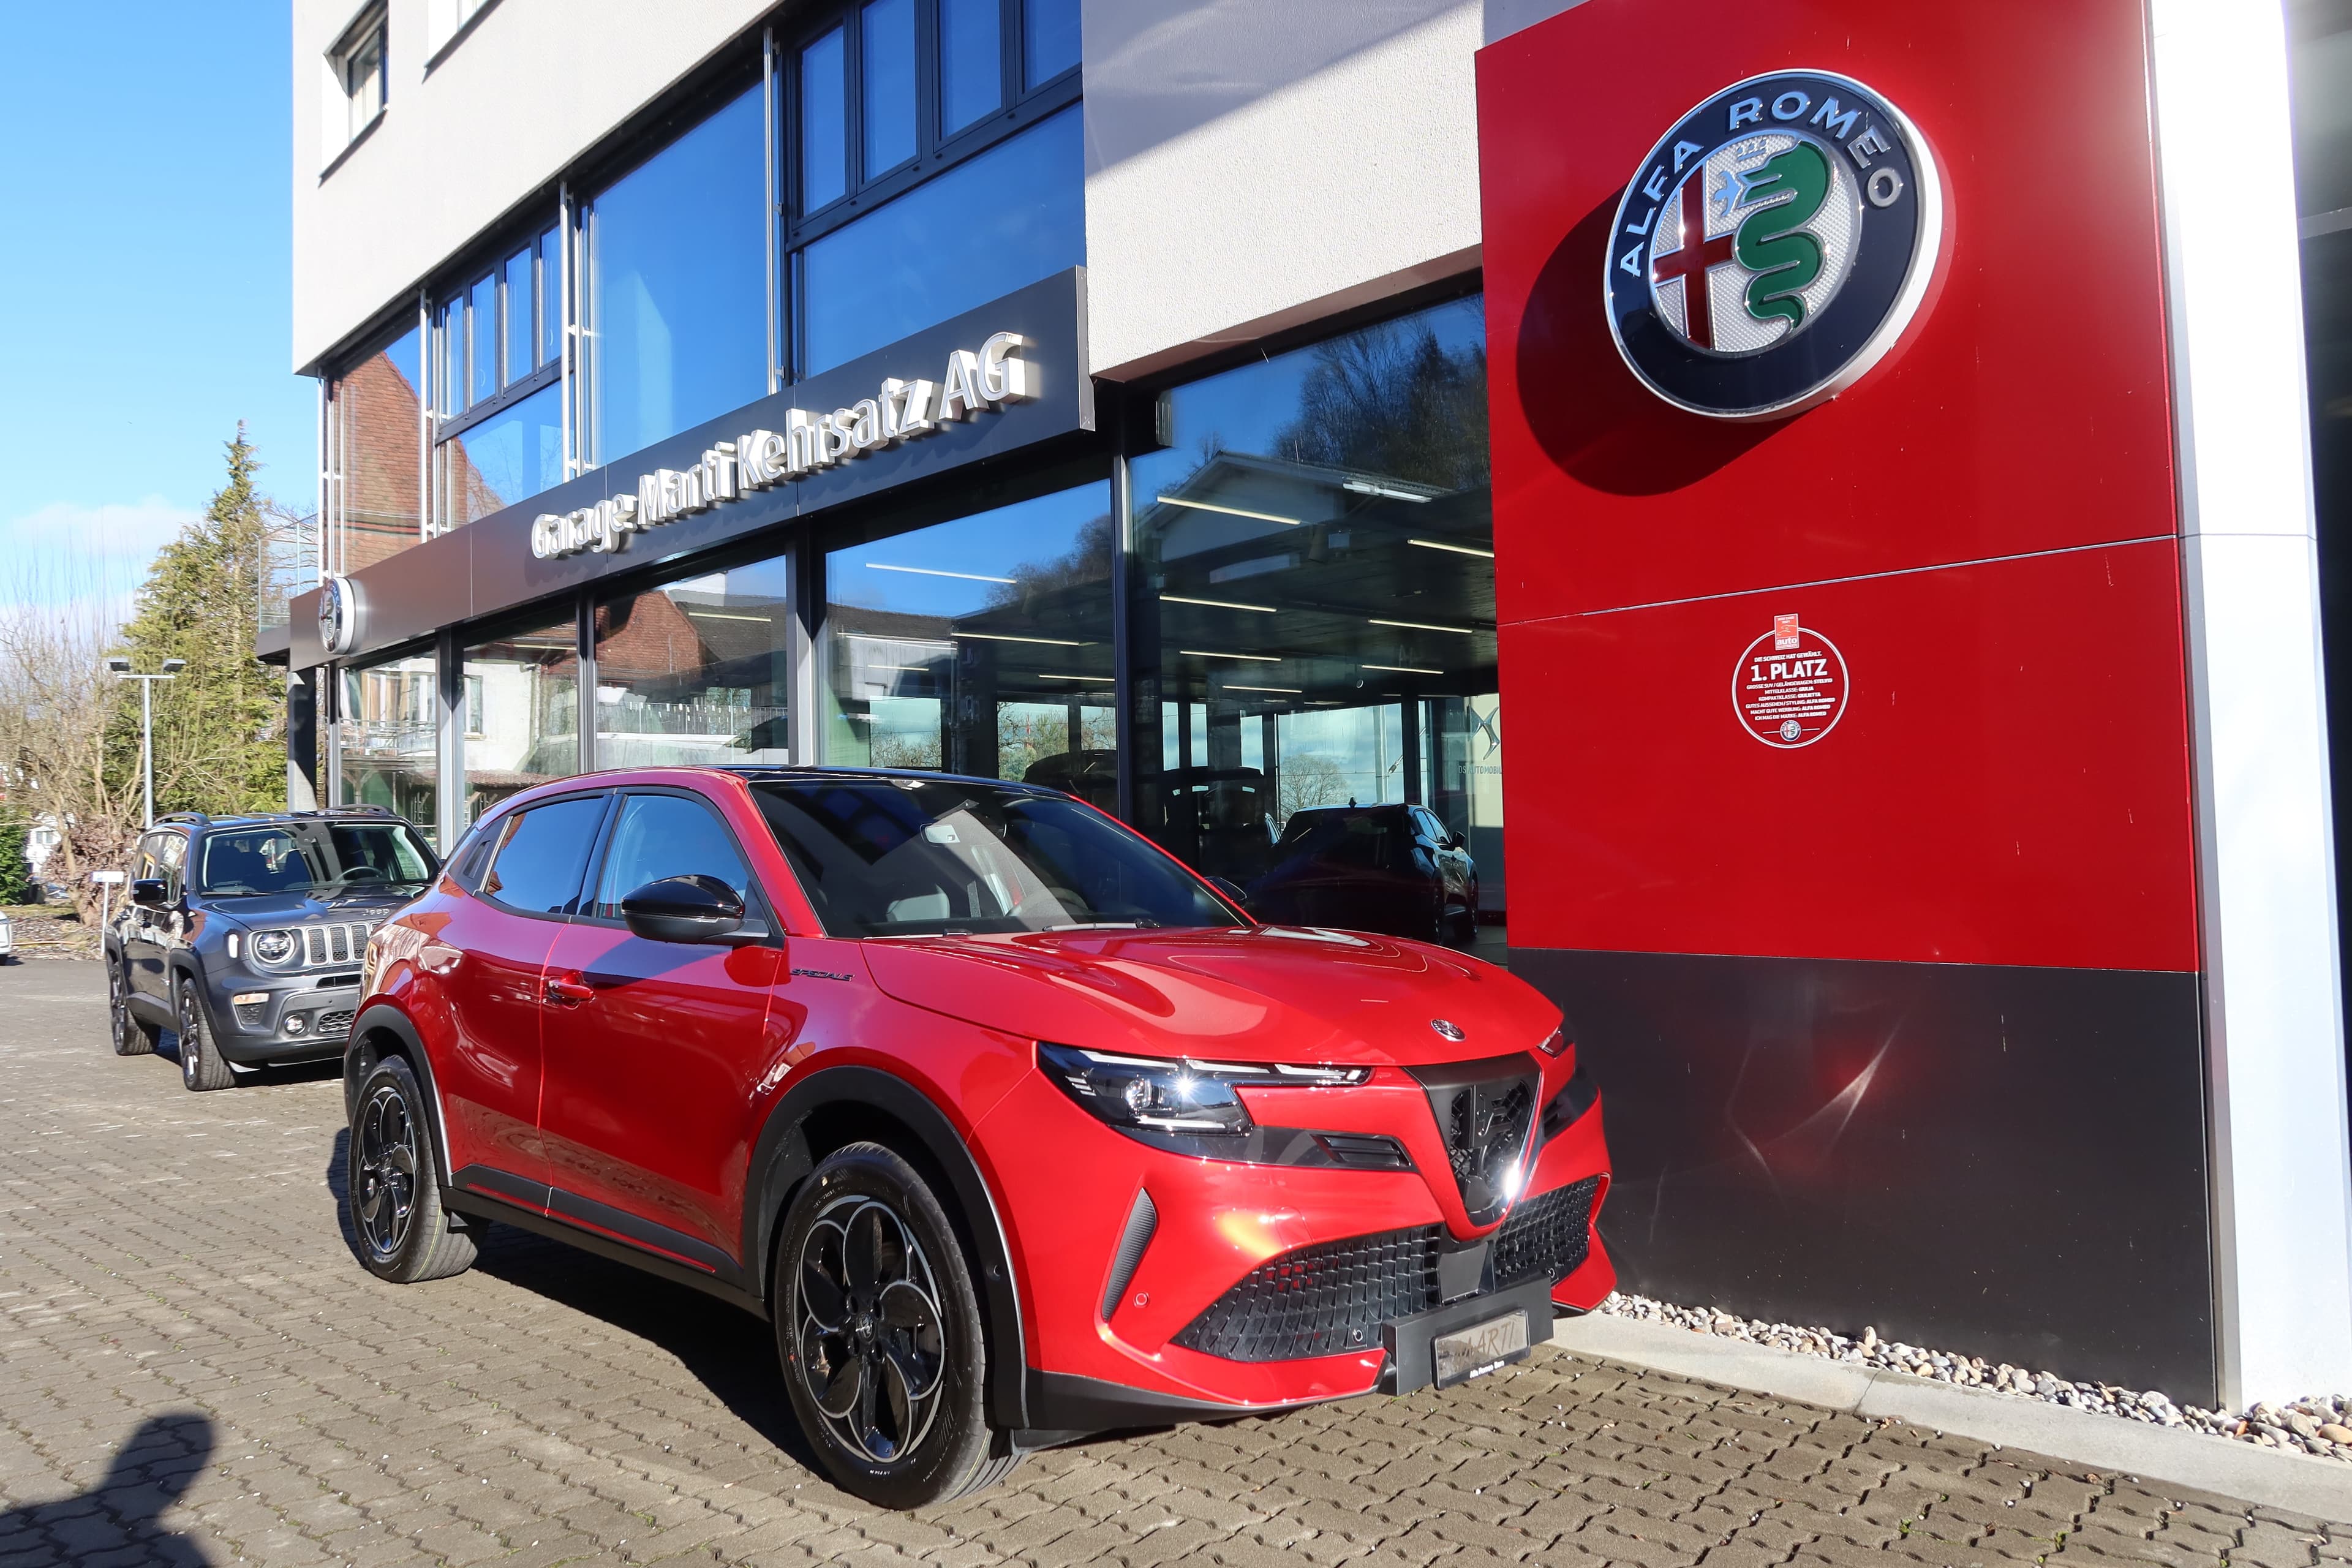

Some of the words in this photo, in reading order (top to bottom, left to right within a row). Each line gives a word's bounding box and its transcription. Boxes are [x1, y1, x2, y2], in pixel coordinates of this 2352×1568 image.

[1620, 140, 1704, 277] ALFA
[1729, 91, 1903, 208] ROMEO
[532, 494, 638, 559] Garage
[637, 441, 735, 525] Marti
[737, 377, 934, 490] Kehrsatz
[938, 331, 1026, 421] AG
[1751, 665, 1767, 682] 1.
[1770, 658, 1828, 680] PLATZ
[1458, 765, 1466, 774] DS
[791, 968, 855, 982] SPECIALE
